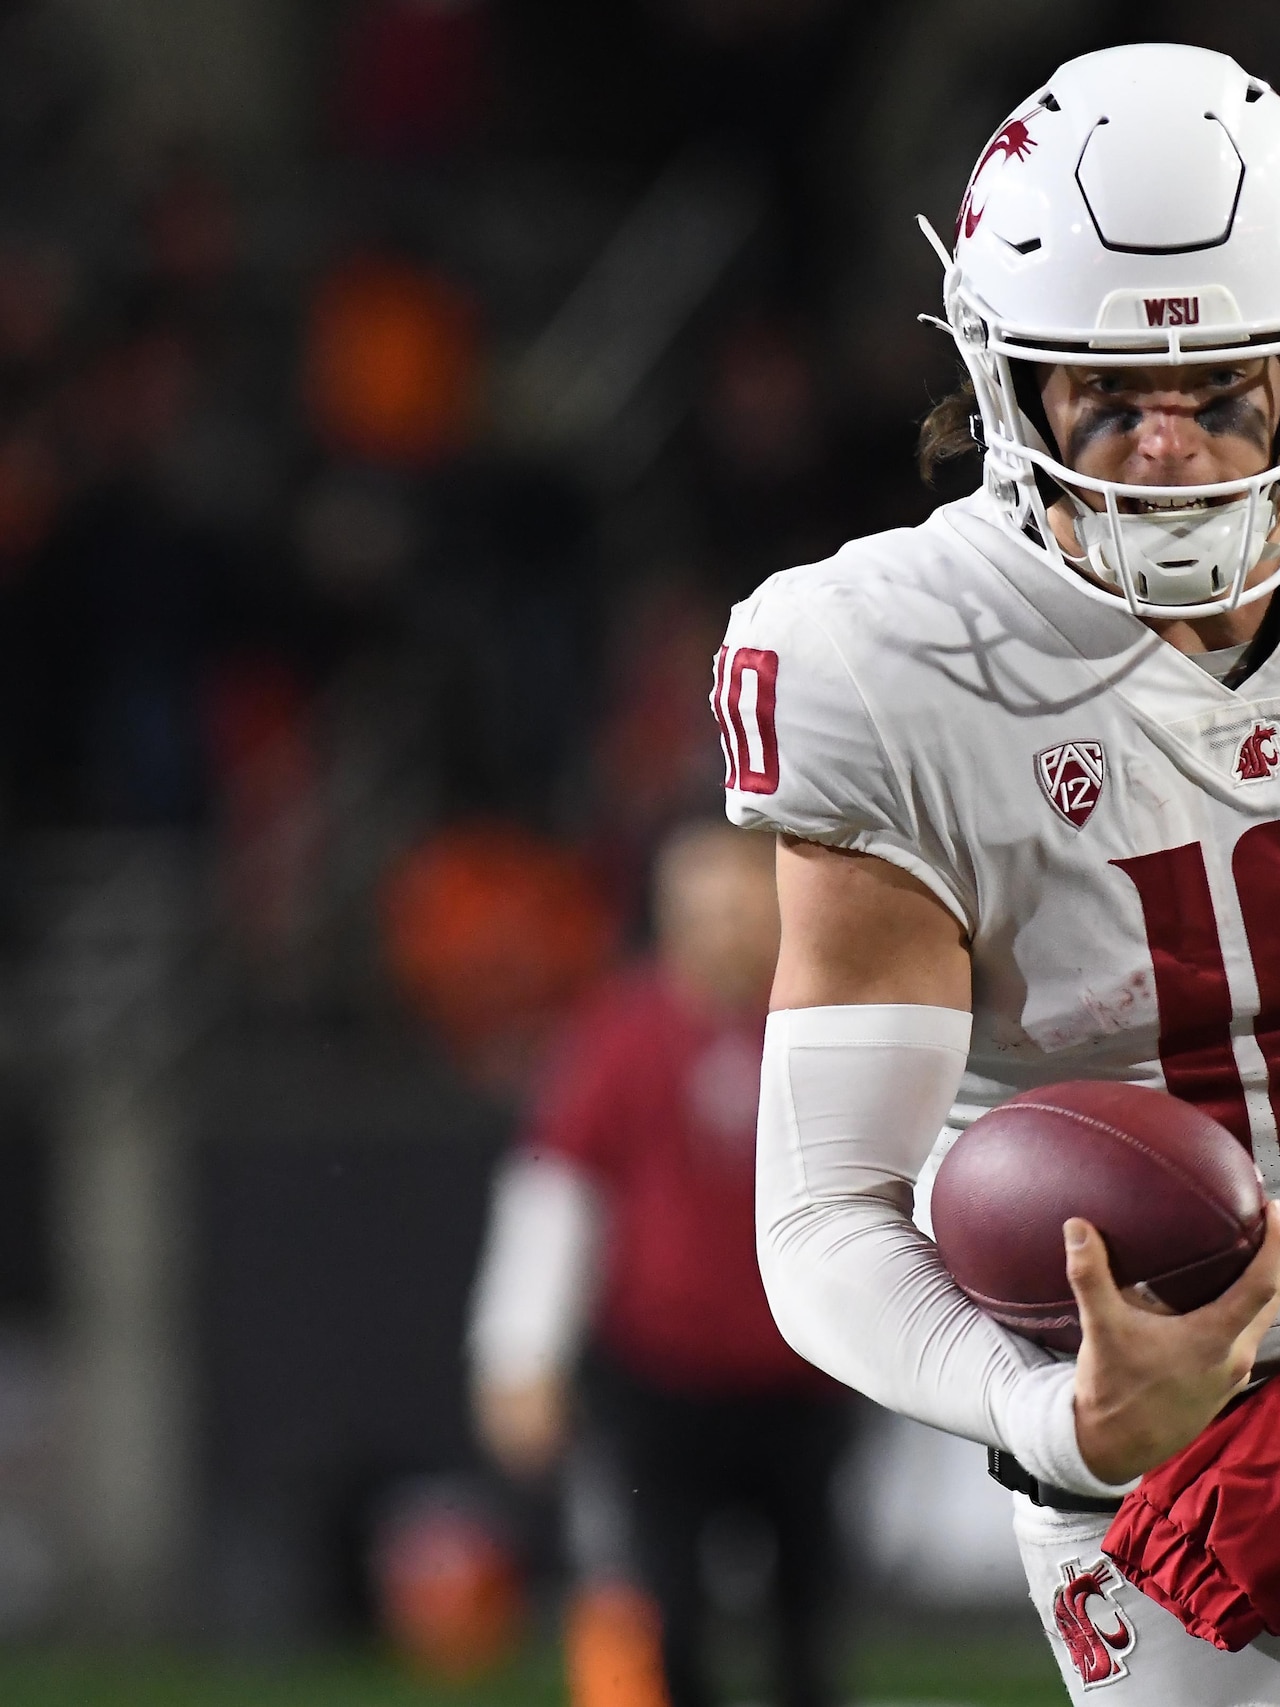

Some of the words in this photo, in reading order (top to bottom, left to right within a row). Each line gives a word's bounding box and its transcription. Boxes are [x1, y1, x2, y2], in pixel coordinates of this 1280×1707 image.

[1143, 296, 1199, 326] WSU
[1041, 743, 1103, 797] PAC
[1060, 776, 1095, 813] 12
